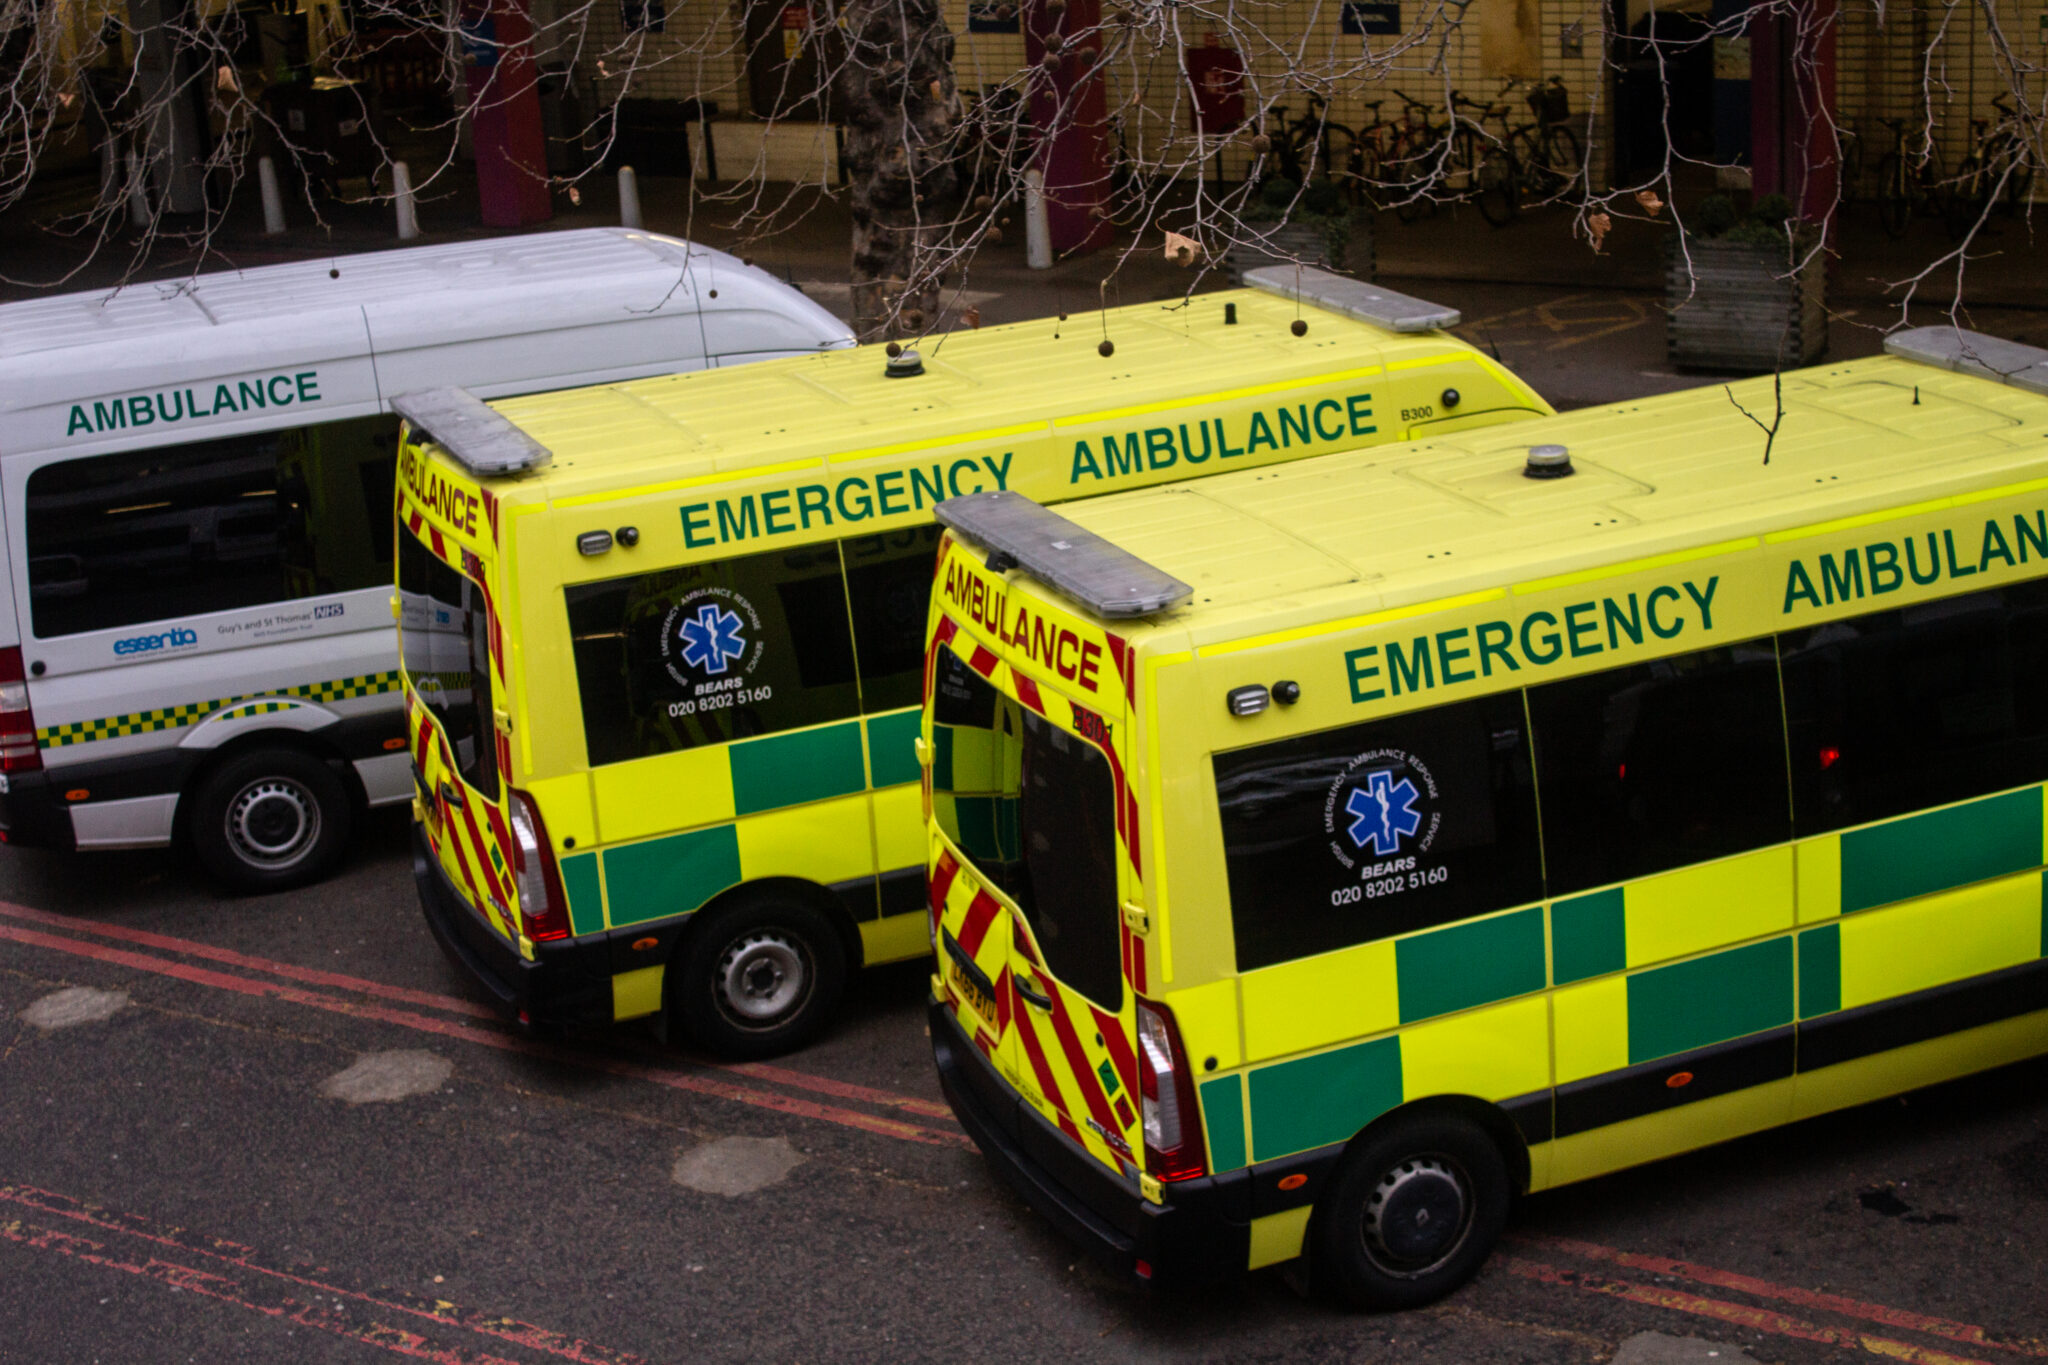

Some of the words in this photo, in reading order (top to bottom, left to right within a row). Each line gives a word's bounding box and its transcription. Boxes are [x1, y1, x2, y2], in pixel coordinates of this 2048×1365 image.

[67, 371, 322, 437] AMBULANCE
[1400, 405, 1433, 422] B300
[679, 452, 1013, 550] EMERGENCY
[1070, 393, 1378, 484] AMBULANCE
[680, 587, 732, 605] AMBULANCE
[217, 623, 242, 635] Guy's
[244, 618, 262, 631] and
[264, 615, 273, 627] St
[315, 604, 344, 619] NHS
[944, 556, 1102, 694] AMBULANCE
[1344, 575, 1719, 704] EMERGENCY
[113, 627, 197, 656] essentia
[668, 700, 696, 717] 020
[699, 693, 735, 711] 8202
[737, 685, 772, 704] 5160
[694, 676, 744, 696] BEARS
[1073, 704, 1113, 747] B301
[1348, 748, 1406, 771] AMBULANCE
[1408, 755, 1439, 799] RESPONSE
[1324, 769, 1347, 833] EMERGENCY
[1419, 812, 1441, 852] SERVICE
[1331, 886, 1362, 906] 020
[1366, 876, 1405, 898] 8202
[1409, 866, 1448, 889] 5160
[1361, 856, 1416, 880] BEARS
